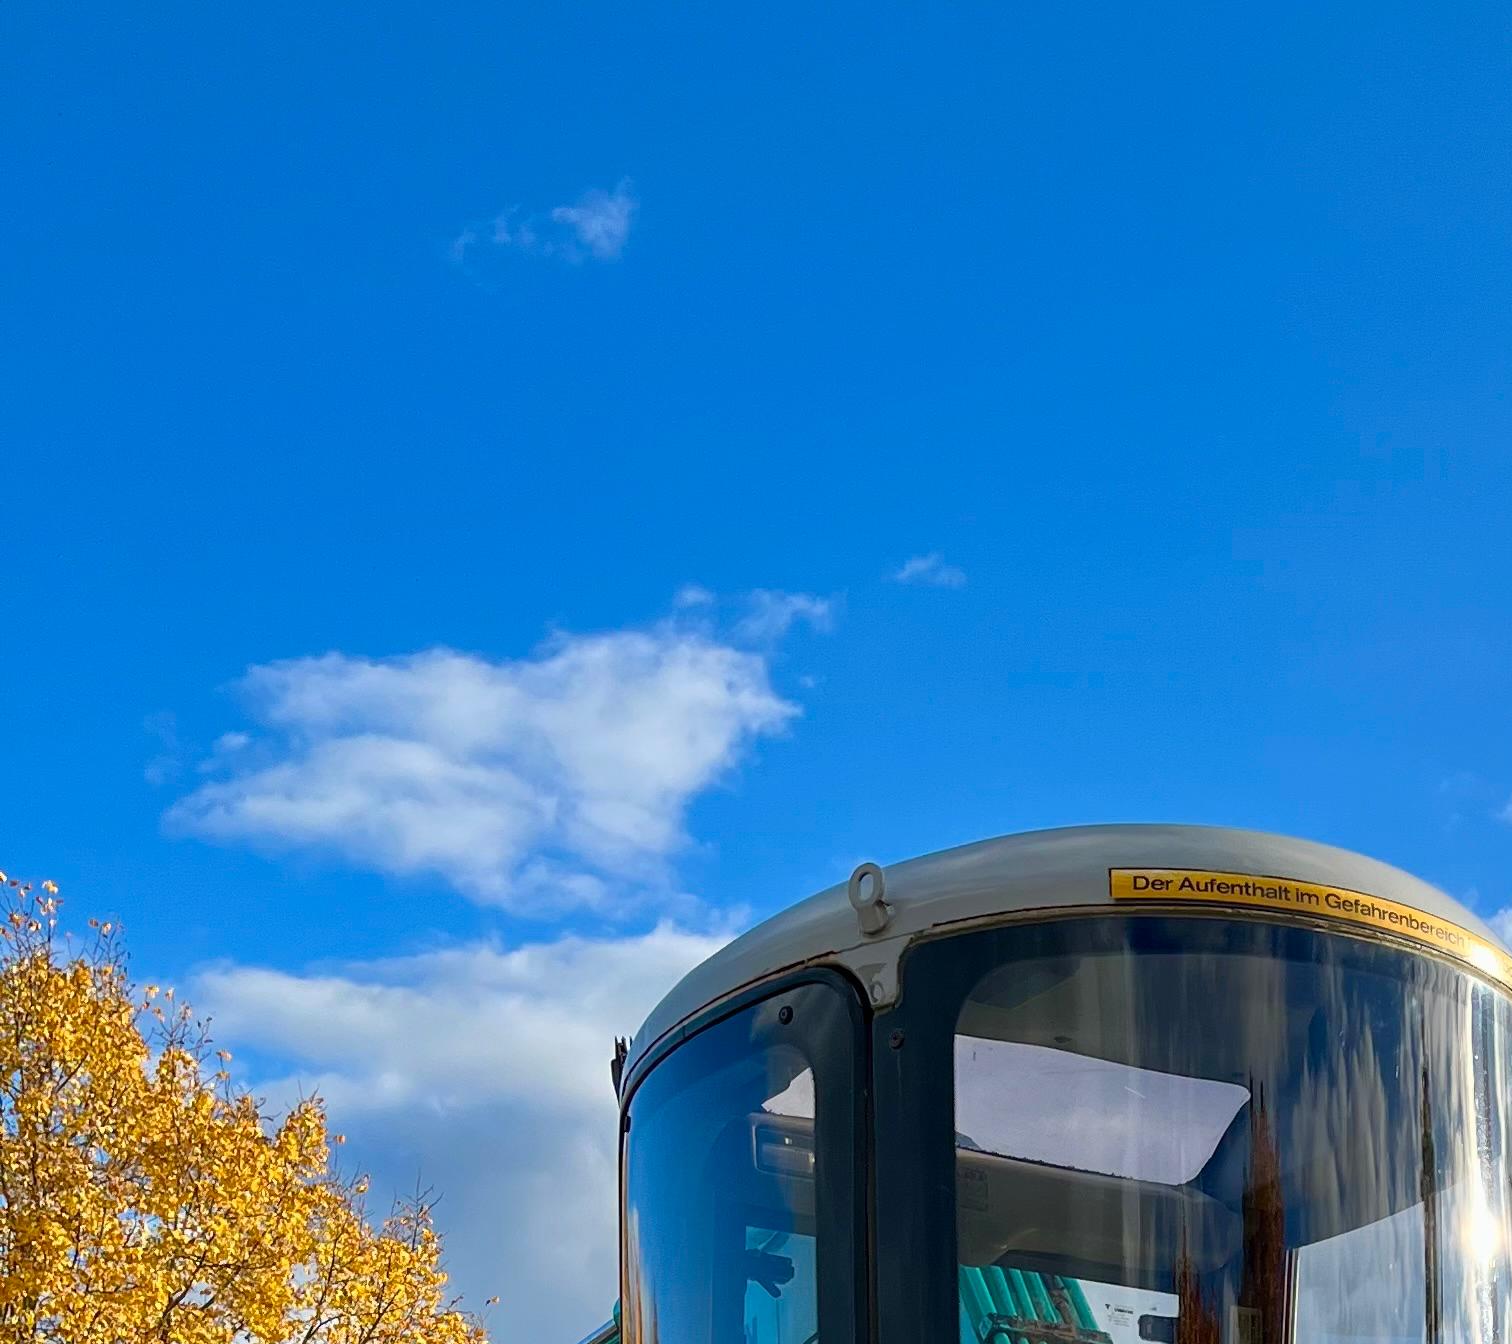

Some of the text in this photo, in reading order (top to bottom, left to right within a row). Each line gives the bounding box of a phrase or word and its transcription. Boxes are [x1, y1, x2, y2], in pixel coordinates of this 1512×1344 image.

[1132, 874, 1466, 949] Der Aufenthalt im Gefahrenbereich
